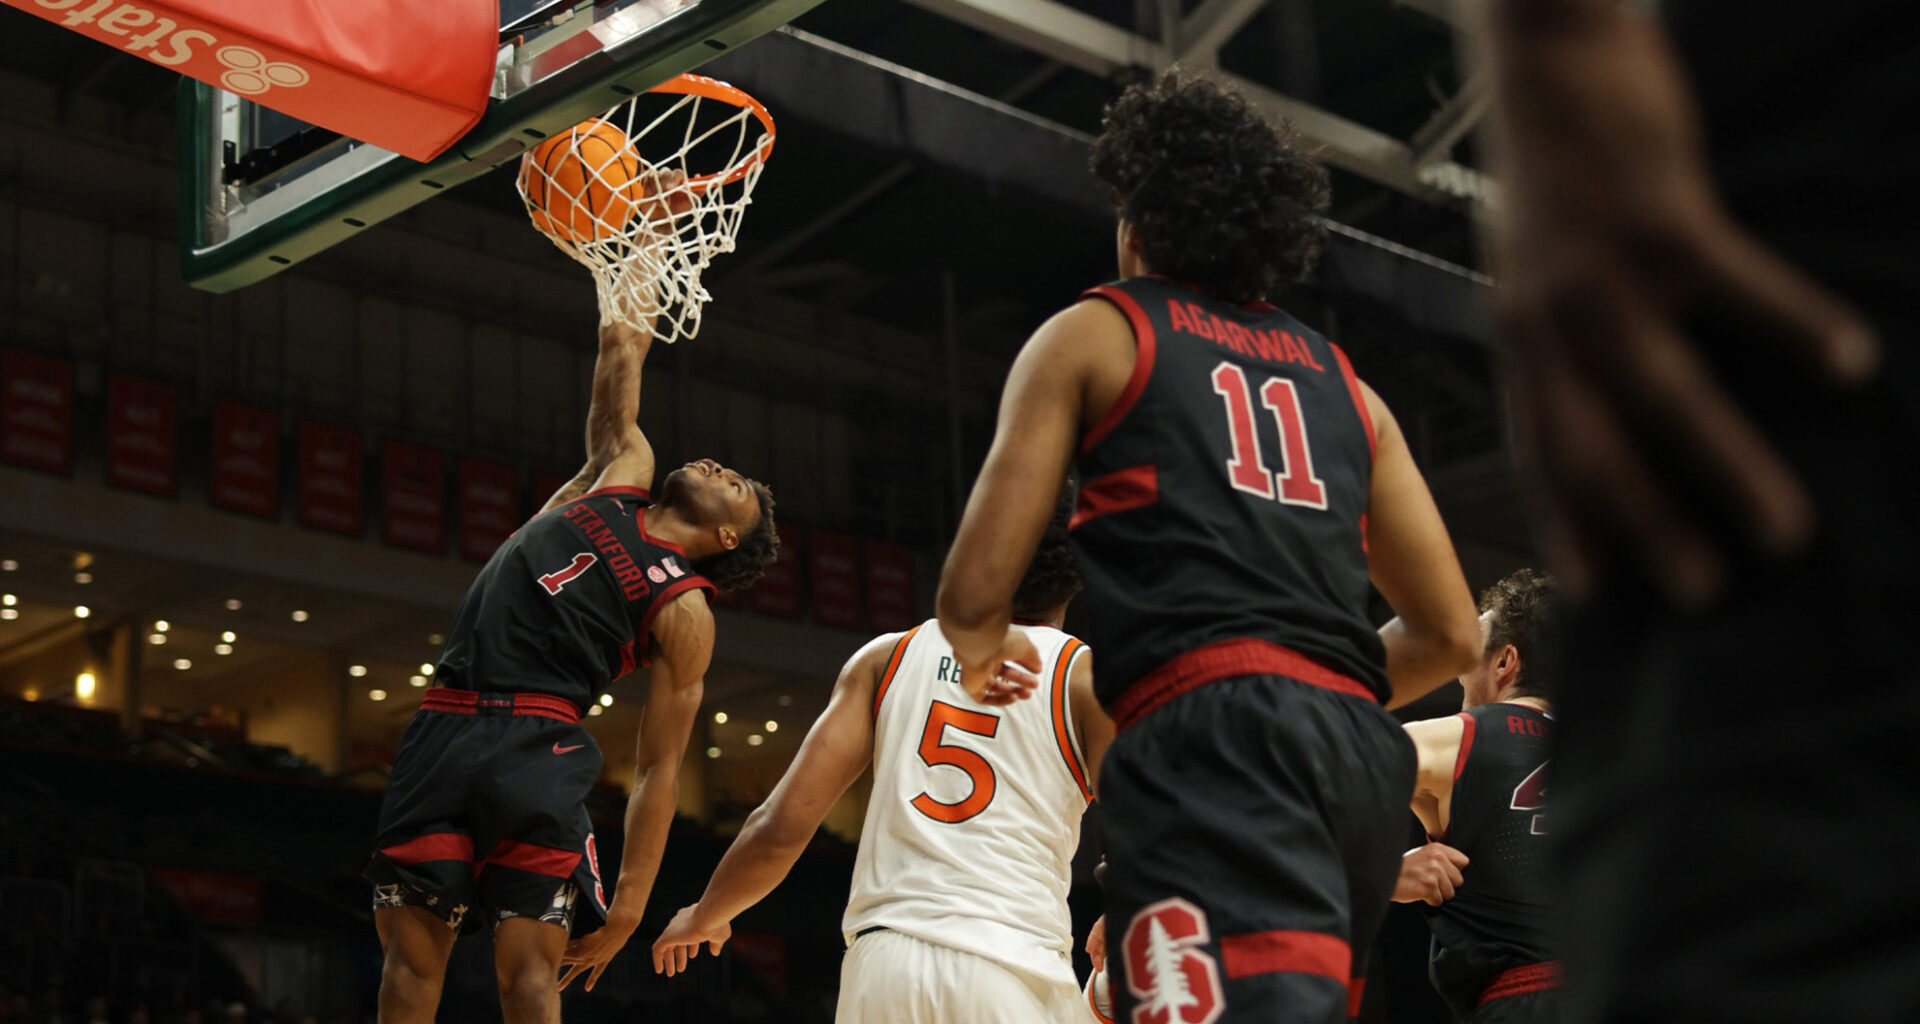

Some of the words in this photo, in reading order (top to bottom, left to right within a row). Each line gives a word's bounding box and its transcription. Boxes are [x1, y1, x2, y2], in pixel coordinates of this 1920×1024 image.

[1167, 297, 1326, 373] AGARWAL
[1210, 360, 1329, 511] 11
[537, 552, 598, 596] 1
[563, 503, 651, 602] STANFORD
[937, 656, 962, 684] RE
[910, 699, 1001, 824] 5
[1506, 715, 1552, 741] RO
